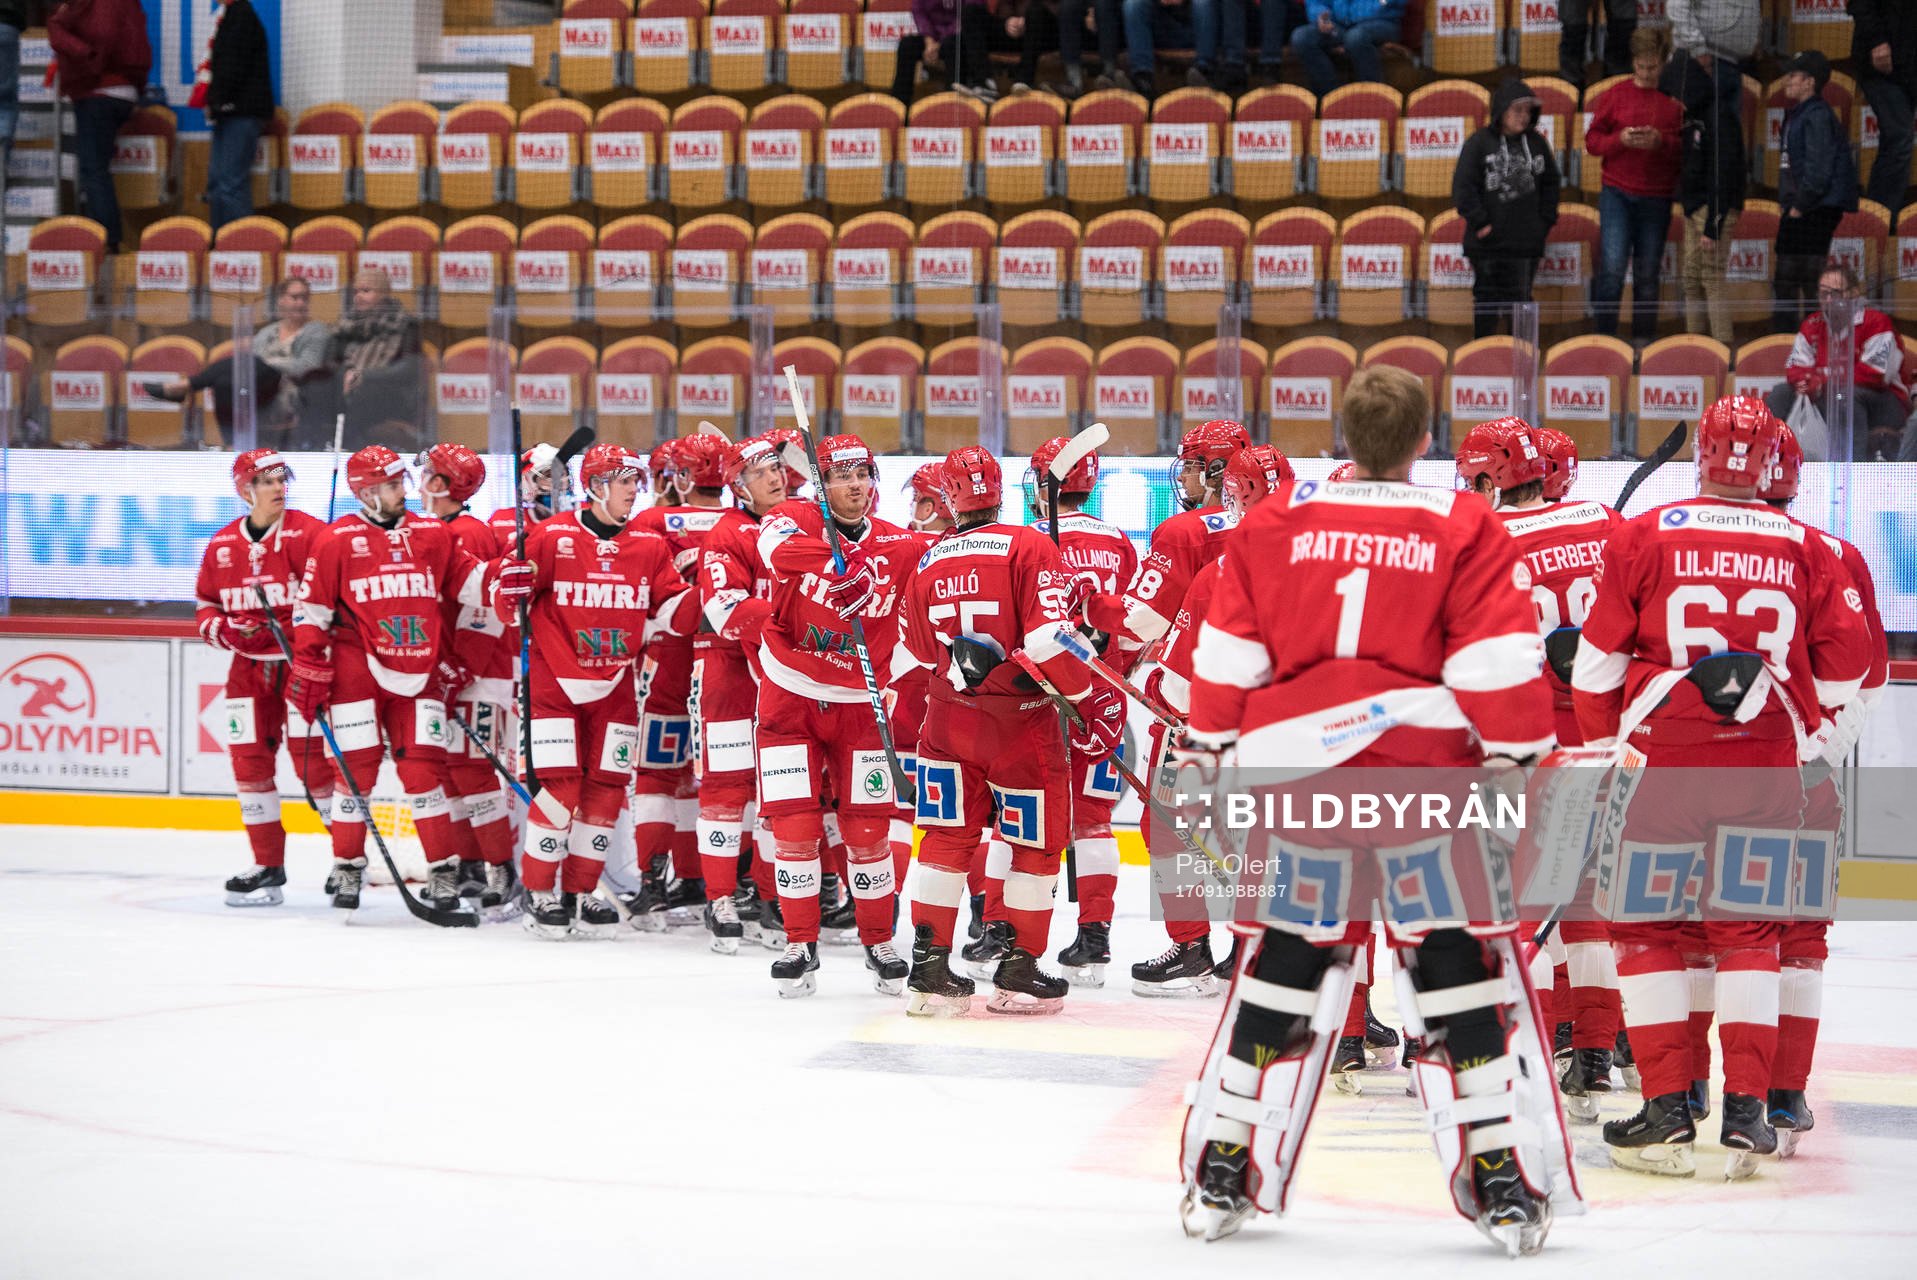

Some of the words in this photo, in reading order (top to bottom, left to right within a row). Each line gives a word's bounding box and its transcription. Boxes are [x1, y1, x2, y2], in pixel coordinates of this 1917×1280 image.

[1441, 8, 1488, 23] MAXI
[565, 29, 607, 43] MAXI
[640, 28, 683, 44] MAXI
[716, 27, 759, 40] MAXI
[787, 25, 834, 40] MAXI
[1072, 136, 1117, 151] MAXI
[1155, 135, 1201, 150] MAXI
[1238, 132, 1286, 147] MAXI
[1326, 131, 1374, 146] MAXI
[1410, 128, 1459, 145] MAXI
[293, 145, 335, 160] MAXI
[368, 145, 411, 160] MAXI
[442, 145, 484, 159] MAXI
[521, 144, 563, 158] MAXI
[597, 144, 639, 158] MAXI
[674, 142, 717, 156] MAXI
[752, 140, 796, 156] MAXI
[831, 139, 874, 154] MAXI
[912, 139, 957, 154] MAXI
[991, 138, 1035, 152] MAXI
[757, 261, 803, 276] MAXI
[838, 260, 884, 275] MAXI
[920, 258, 966, 274] MAXI
[1003, 258, 1050, 274] MAXI
[1089, 258, 1136, 274] MAXI
[1170, 261, 1217, 275] MAXI
[1259, 256, 1307, 273] MAXI
[1347, 256, 1398, 272] MAXI
[1540, 256, 1577, 272] AXI
[1730, 253, 1764, 269] AXI
[32, 262, 79, 277] MAXI
[140, 264, 183, 278] MAXI
[213, 263, 256, 278] MAXI
[444, 263, 487, 278] MAXI
[518, 262, 564, 277] MAXI
[600, 262, 646, 277] MAXI
[677, 261, 722, 278] MAXI
[55, 381, 99, 397] MAXI
[520, 384, 565, 400] MAXI
[602, 385, 647, 400] MAXI
[682, 386, 727, 401] MAXI
[848, 387, 894, 402] MAXI
[930, 384, 977, 401] MAXI
[1012, 386, 1060, 404] MAXI
[1100, 387, 1149, 403] MAXI
[1275, 387, 1327, 406] MAXI
[1456, 387, 1508, 406] MAXI
[1551, 386, 1604, 406] MAXI
[1644, 386, 1698, 405] MAXI
[1727, 457, 1747, 470] 63
[973, 484, 987, 495] 55
[1325, 482, 1371, 497] Grant
[1377, 485, 1449, 508] Thornton
[1697, 511, 1741, 525] Grant
[876, 533, 912, 543] stadium
[933, 543, 960, 557] Grant
[961, 539, 1009, 550] Thornton
[1289, 530, 1437, 574] BRATTSTRÖM
[1151, 551, 1172, 568] SCA
[349, 565, 437, 603] TIMRÅ
[934, 568, 980, 599] GALLÓ
[553, 576, 650, 610] TIMRÅ
[799, 572, 897, 619] TIRÅ
[1335, 567, 1370, 658] 1
[1667, 585, 1797, 680] 63
[861, 754, 888, 763] ŠKOD
[727, 835, 741, 843] SC
[791, 874, 814, 884] SCA
[872, 871, 891, 885] SCA
